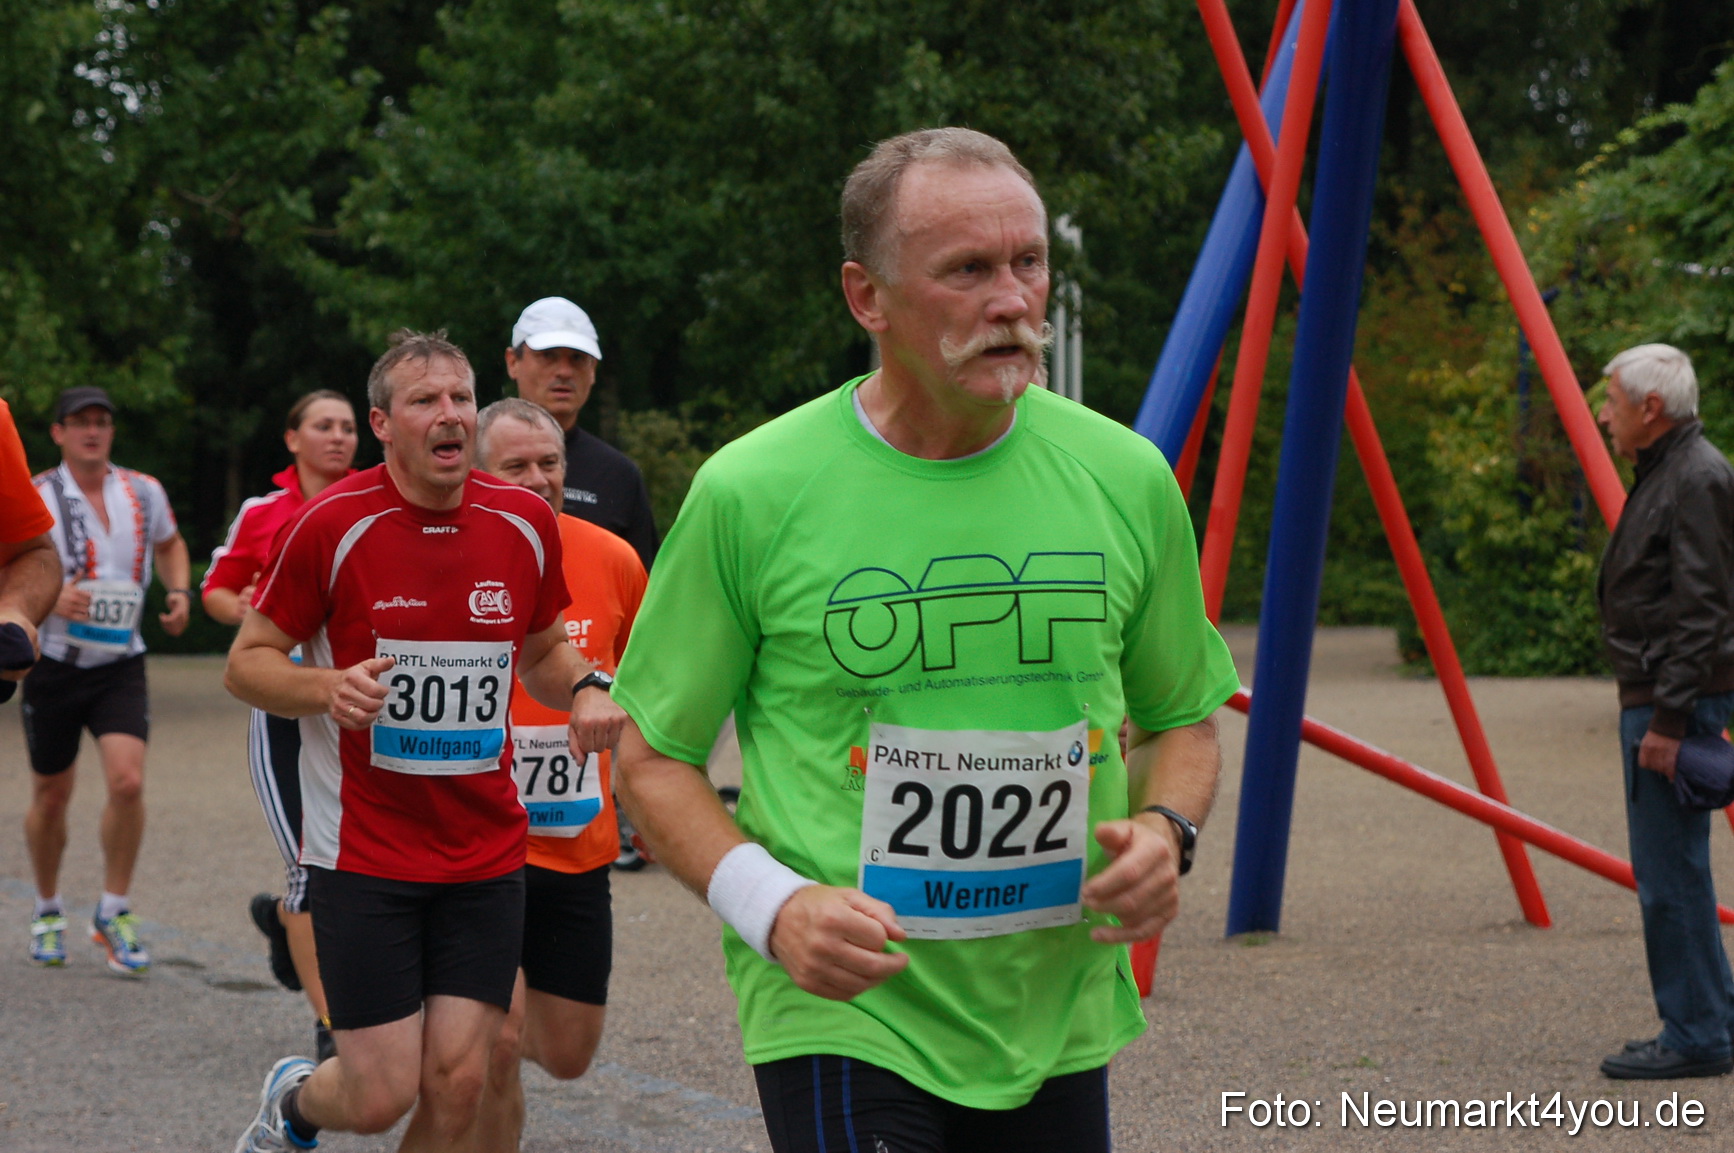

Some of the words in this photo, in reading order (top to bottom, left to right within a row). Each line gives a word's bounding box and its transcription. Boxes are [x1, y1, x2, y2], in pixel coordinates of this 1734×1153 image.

[423, 526, 450, 534] CRAFT
[89, 600, 136, 624] 037
[823, 552, 1107, 679] OPF
[431, 655, 492, 667] Neumarkt
[388, 673, 499, 723] 3013
[836, 687, 895, 698] Gebäude-
[899, 680, 921, 694] und
[925, 671, 1073, 690] Automatisierungstechnik
[400, 735, 481, 759] Wolfgang
[529, 739, 569, 749] Neuma
[874, 745, 950, 770] PARTL
[958, 752, 1062, 772] Neumarkt
[512, 753, 588, 796] 787
[529, 807, 564, 823] rwin
[888, 780, 1072, 860] 2022
[925, 880, 1029, 910] Werner
